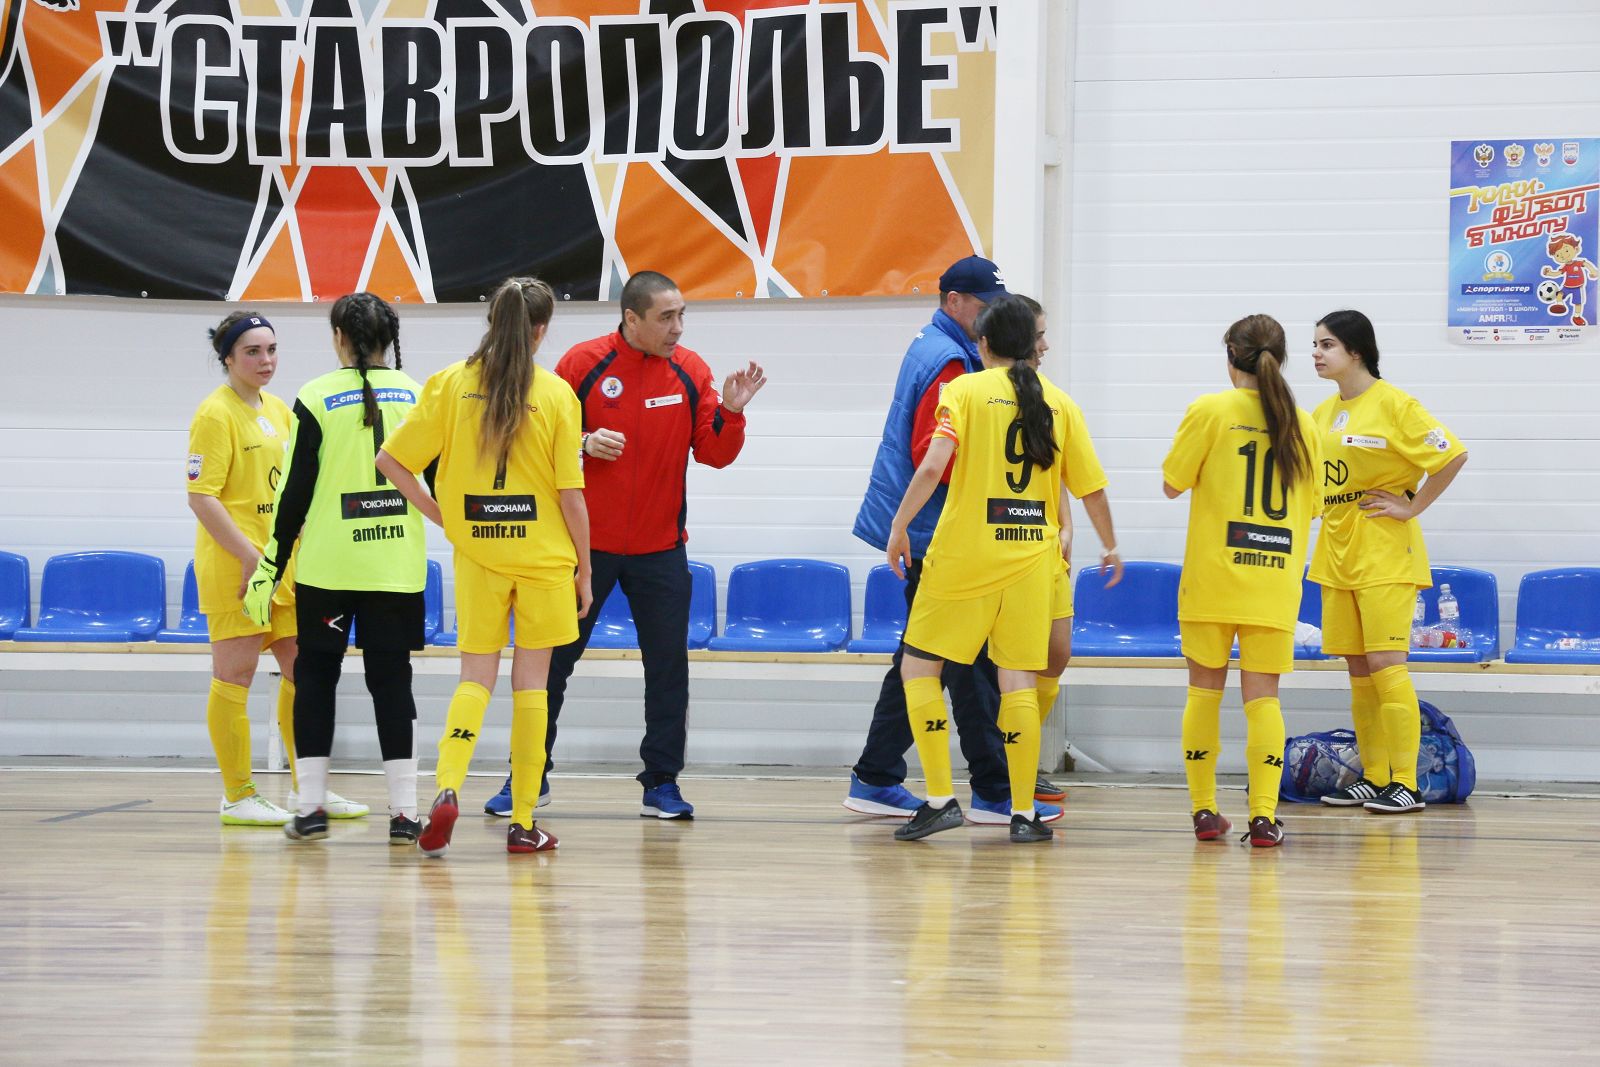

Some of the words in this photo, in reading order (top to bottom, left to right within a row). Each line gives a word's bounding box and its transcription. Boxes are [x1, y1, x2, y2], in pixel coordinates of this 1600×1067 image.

[1005, 418, 1034, 494] 9
[1238, 440, 1288, 521] 10
[360, 498, 404, 509] YOKOHAMA
[483, 503, 532, 513] YOKOHAMA
[1007, 507, 1043, 517] YOKOHAMA
[352, 524, 405, 542] amfr.ru
[472, 523, 527, 539] amfr.ru
[995, 525, 1044, 541] amfr.ru
[1247, 531, 1290, 545] YOKOHAMA
[1233, 551, 1285, 569] amfr.ru
[925, 719, 948, 732] 2K
[450, 728, 476, 742] 2K
[1185, 750, 1209, 760] 2K
[1263, 754, 1284, 768] 2K
